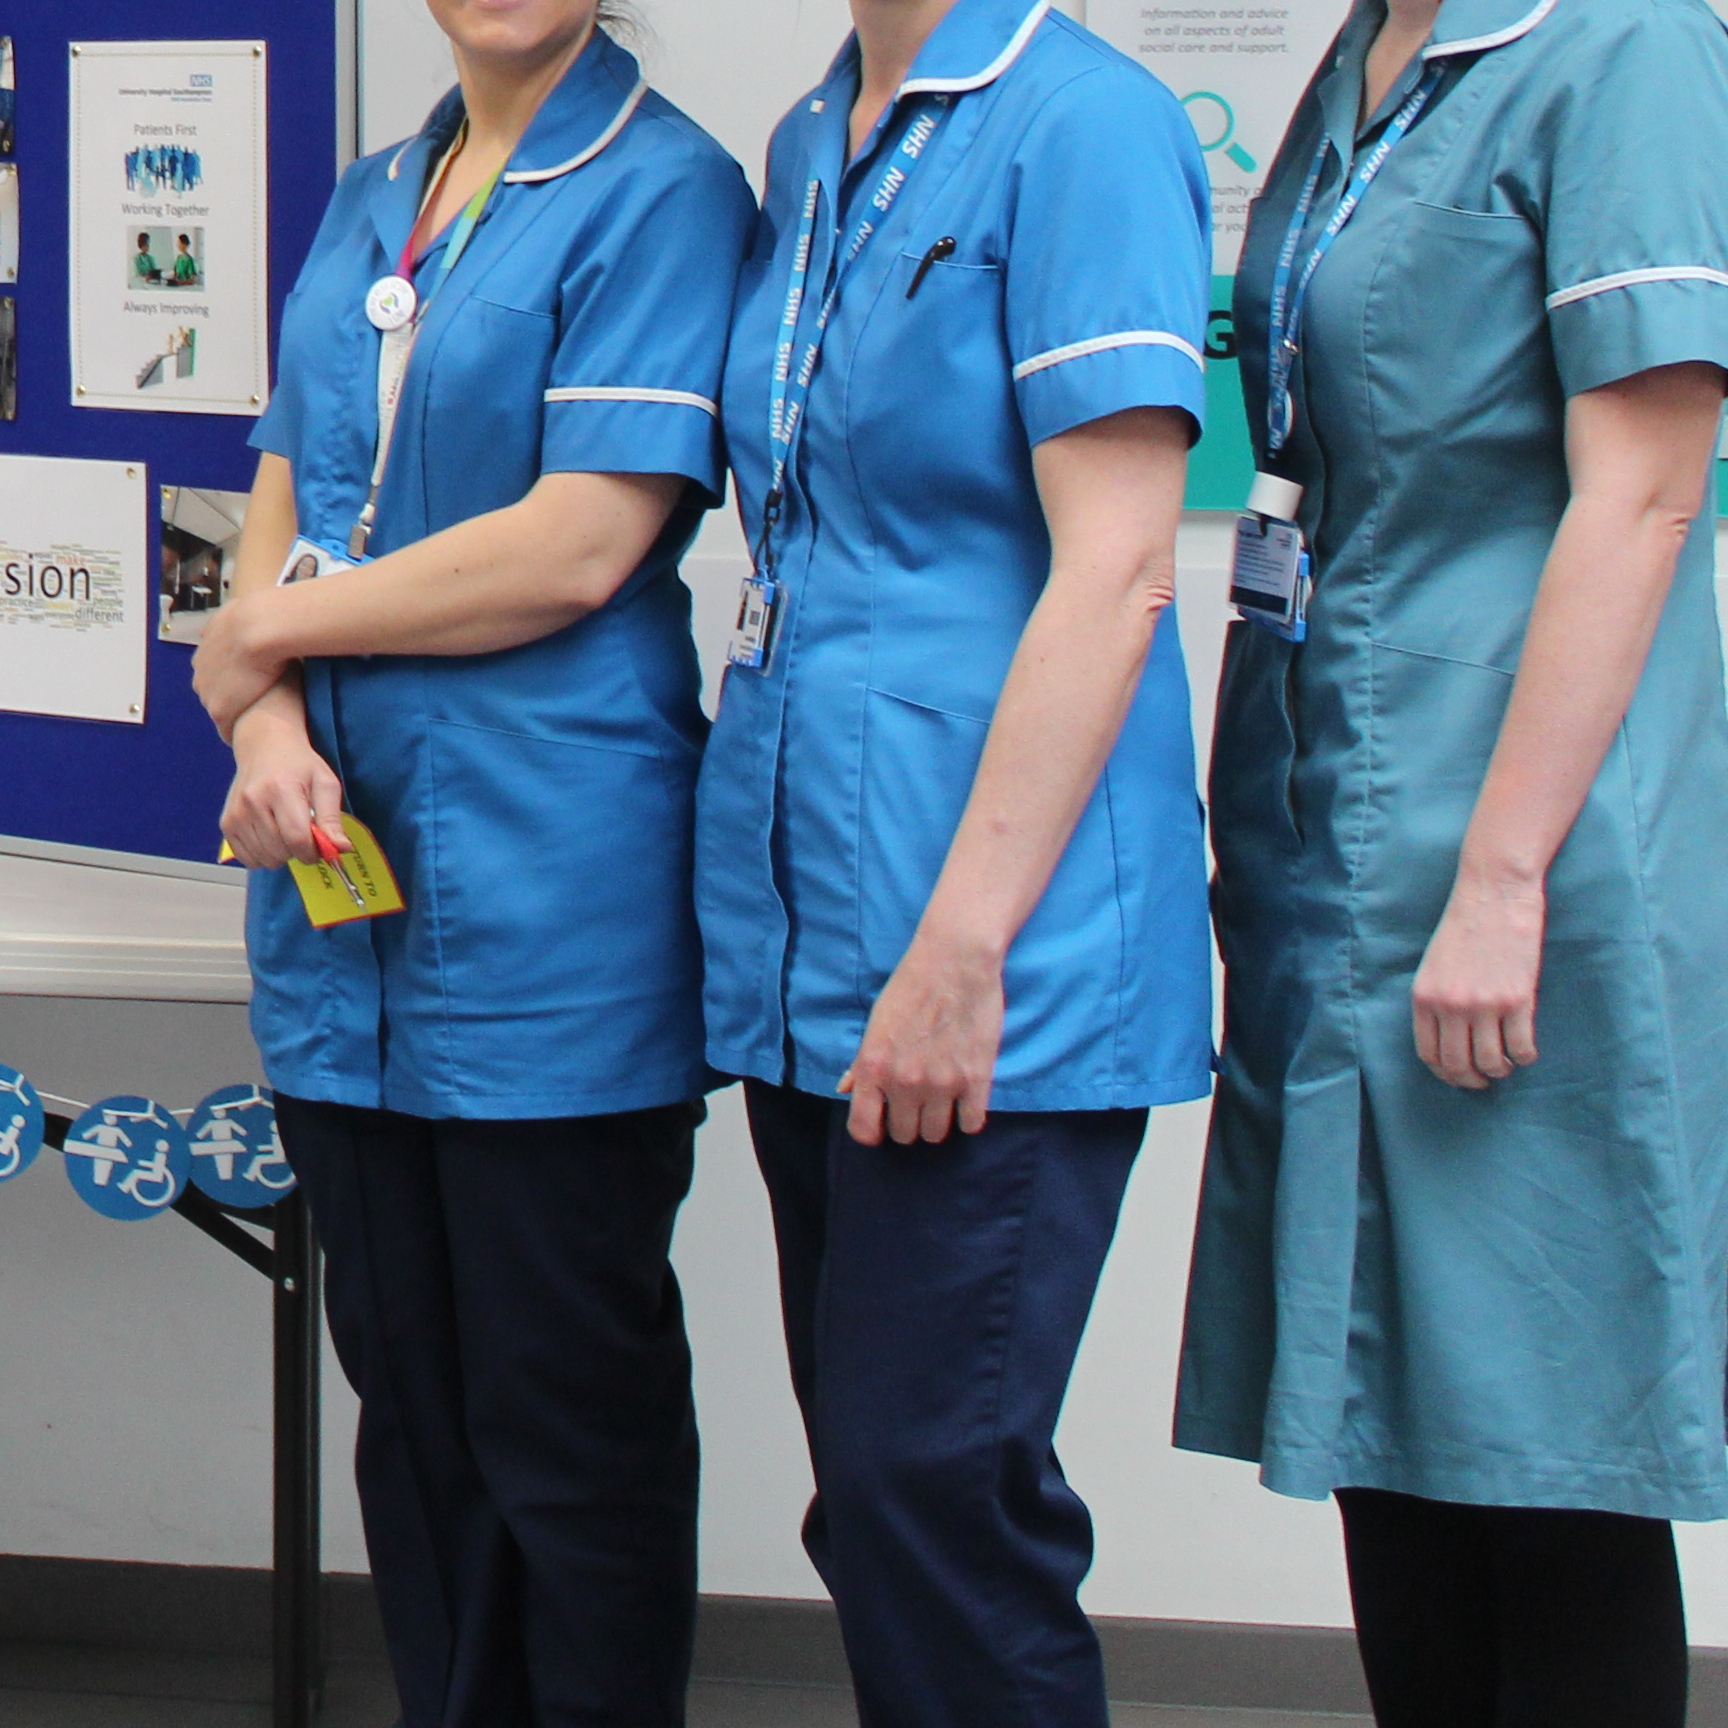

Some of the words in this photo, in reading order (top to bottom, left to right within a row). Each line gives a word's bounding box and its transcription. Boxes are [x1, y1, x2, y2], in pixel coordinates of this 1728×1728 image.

[1140, 8, 1216, 21] Information
[1219, 8, 1244, 19] and
[1247, 8, 1289, 20] advice
[1145, 27, 1162, 36] on
[1164, 25, 1181, 36] all
[1184, 26, 1231, 38] aspects
[1234, 25, 1248, 37] of
[1250, 25, 1284, 36] adult
[1139, 41, 1175, 53] social
[1178, 44, 1207, 53] care
[1209, 42, 1234, 52] and
[1237, 42, 1289, 55] support.
[134, 124, 173, 136] Patients
[176, 124, 196, 136] First
[902, 114, 937, 159] NHS
[122, 203, 163, 217] Working
[165, 204, 209, 218] Together
[1327, 194, 1358, 237] NHS
[123, 301, 158, 316] Always
[160, 302, 209, 318] Improving
[75, 609, 124, 622] different
